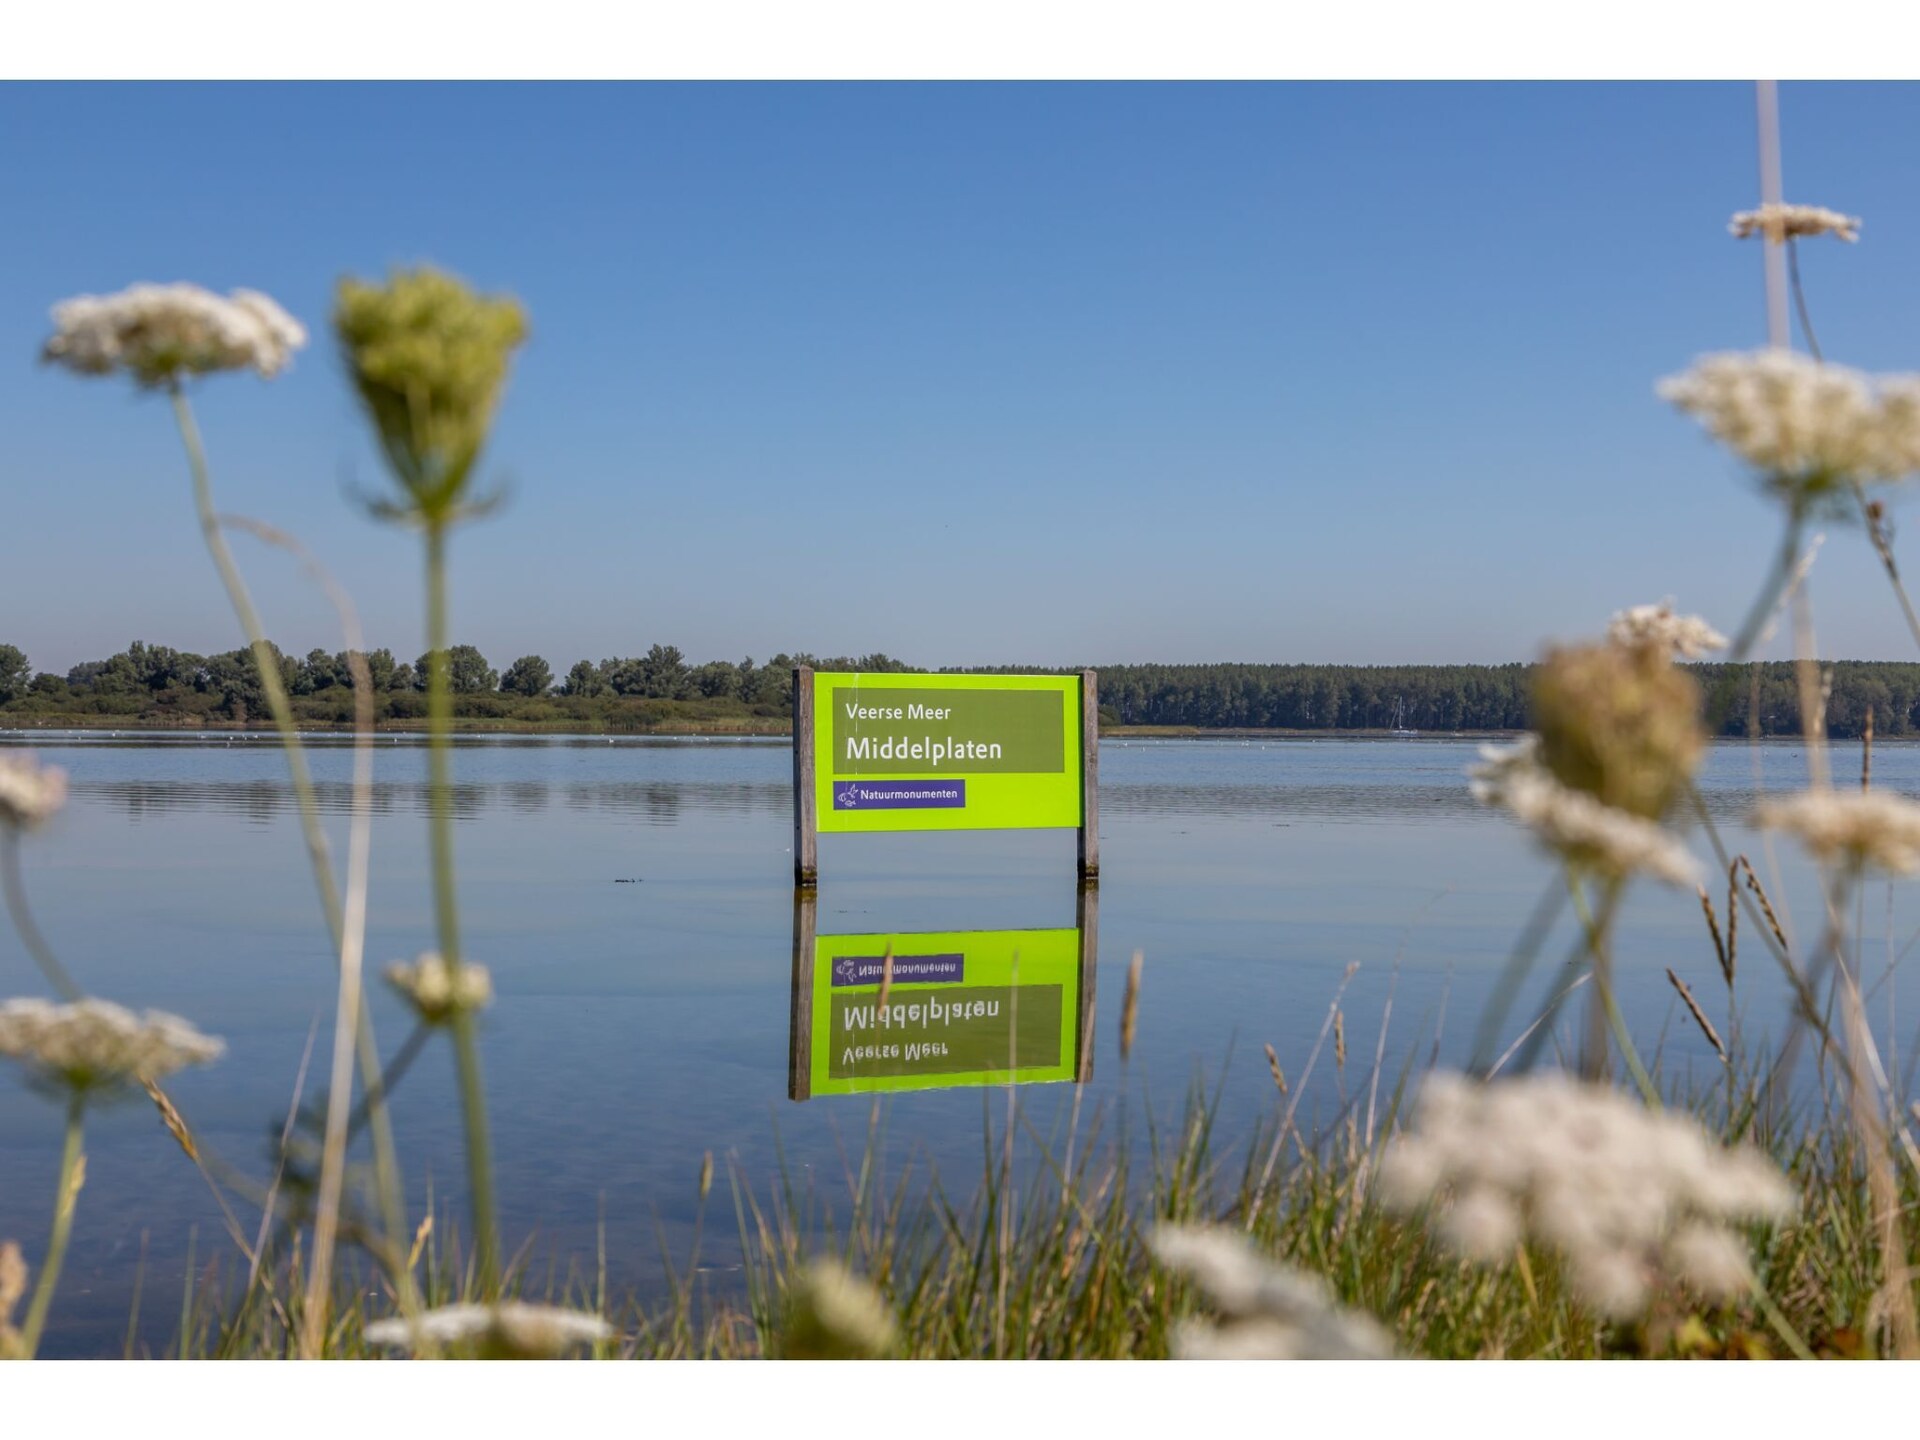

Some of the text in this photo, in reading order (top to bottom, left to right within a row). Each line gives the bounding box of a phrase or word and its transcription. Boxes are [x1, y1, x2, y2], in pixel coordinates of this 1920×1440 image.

[845, 703, 951, 720] Veerse Meer
[847, 737, 1002, 766] Middelplaten
[860, 789, 958, 800] Natuurmonumenten
